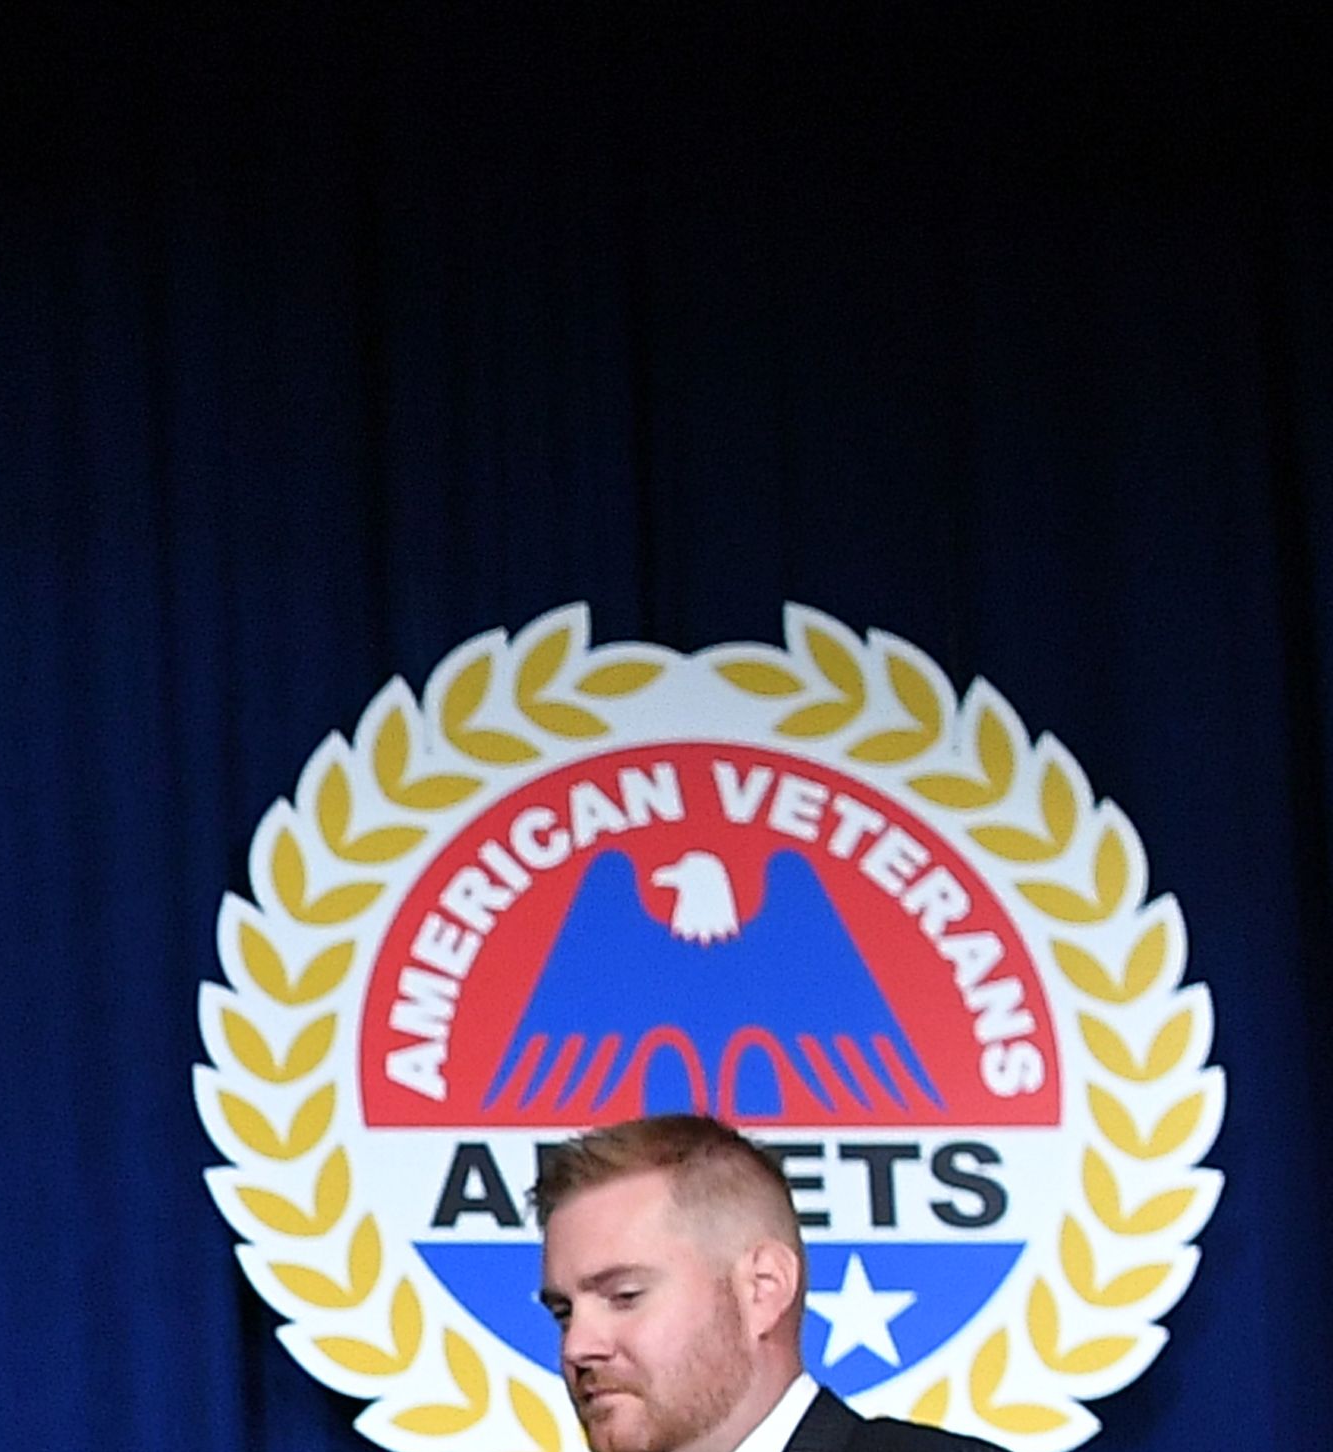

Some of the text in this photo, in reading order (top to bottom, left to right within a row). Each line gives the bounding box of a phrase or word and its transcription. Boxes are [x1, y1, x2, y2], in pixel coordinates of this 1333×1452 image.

[385, 762, 1045, 1101] AMERICAN VETERANS
[430, 1141, 1009, 1229] AETS
